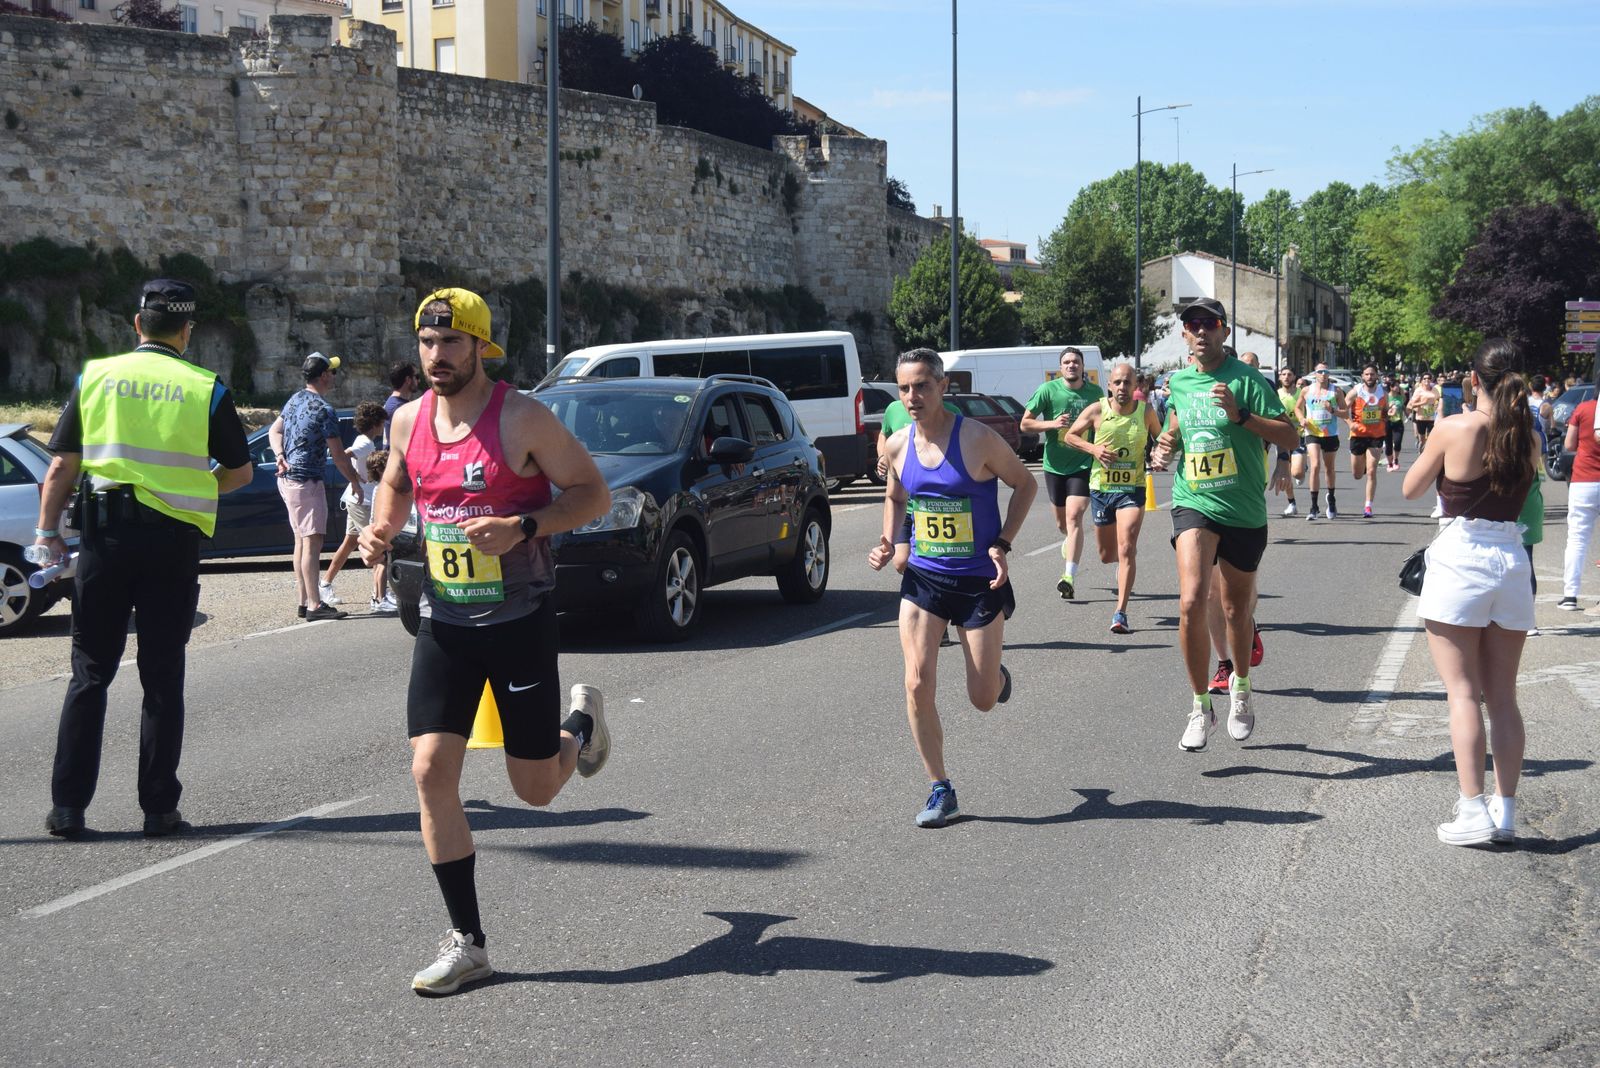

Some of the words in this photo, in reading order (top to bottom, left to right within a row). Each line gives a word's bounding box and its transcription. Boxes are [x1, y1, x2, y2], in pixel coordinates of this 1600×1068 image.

[458, 320, 475, 332] NIKE
[104, 378, 185, 403] POLICÍA
[1366, 411, 1376, 419] 35
[1190, 453, 1225, 477] 147
[1104, 470, 1131, 483] 109
[1215, 479, 1235, 488] RURAL
[926, 516, 957, 539] 55
[442, 548, 475, 578] 81
[447, 587, 465, 597] CAJA
[467, 587, 499, 597] RURAL
